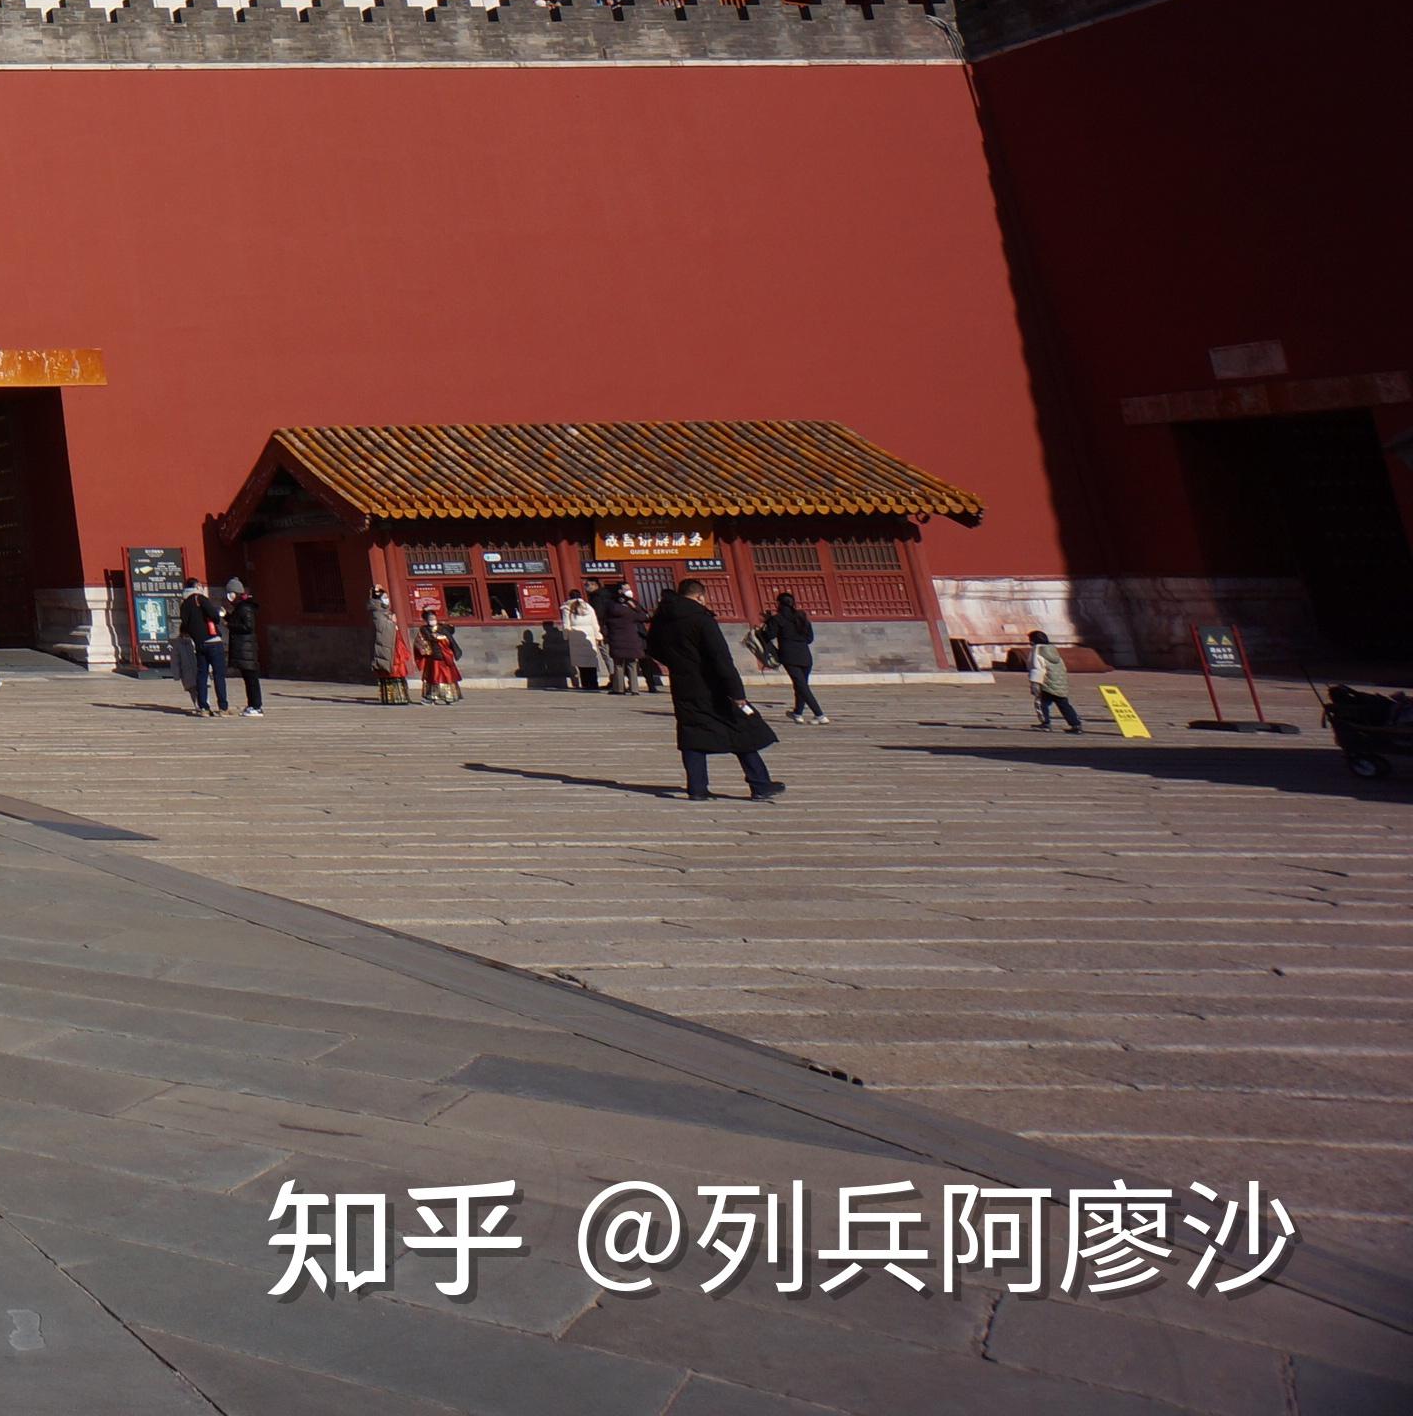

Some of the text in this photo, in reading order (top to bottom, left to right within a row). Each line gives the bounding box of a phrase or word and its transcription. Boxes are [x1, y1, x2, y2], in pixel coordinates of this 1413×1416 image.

[605, 532, 703, 548] 故宫讲解服务
